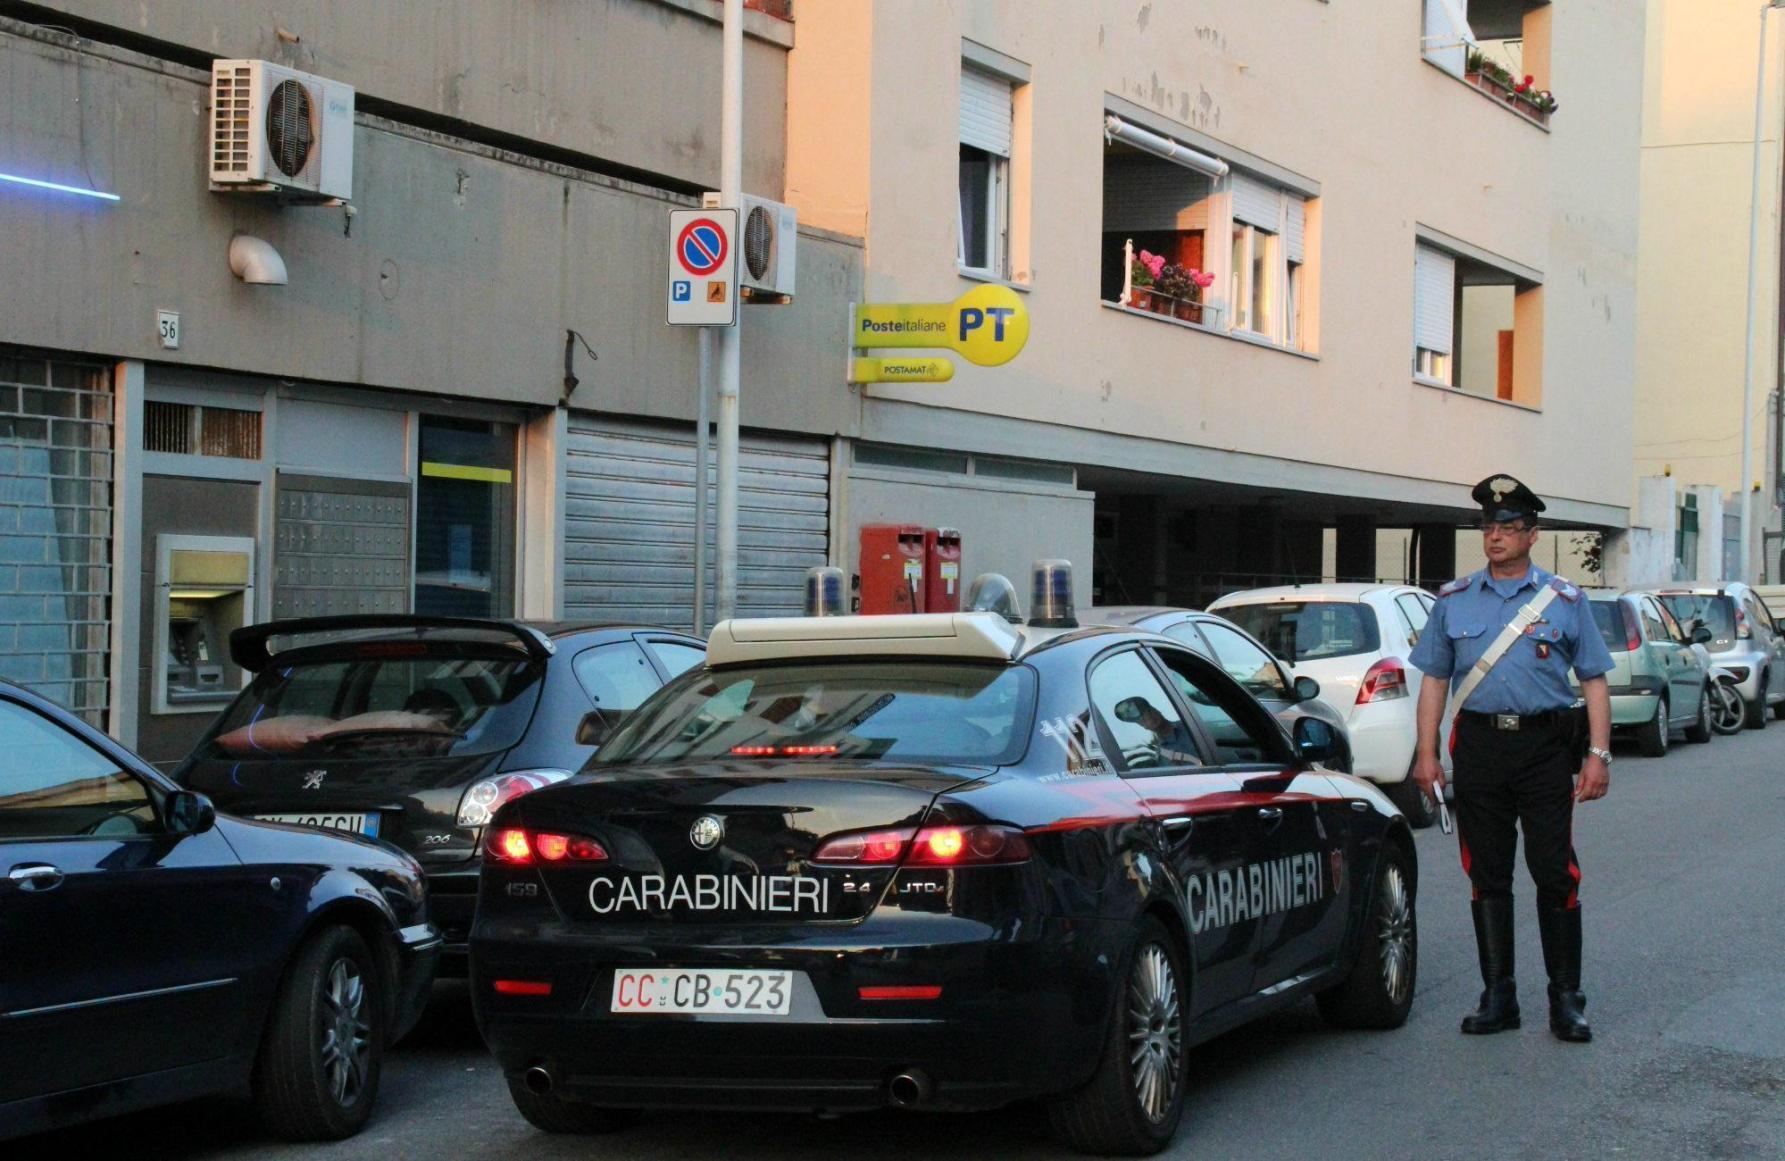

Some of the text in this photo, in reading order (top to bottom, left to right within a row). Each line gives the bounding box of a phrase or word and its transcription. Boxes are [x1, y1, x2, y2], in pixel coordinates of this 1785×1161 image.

[675, 282, 687, 299] P
[160, 320, 176, 339] 36
[960, 307, 1014, 342] PT
[884, 366, 926, 374] POSTAMAT
[1040, 714, 1106, 763] 112
[425, 835, 451, 844] 206
[506, 882, 538, 897] 159
[588, 873, 828, 915] CARABINIERI
[1187, 851, 1323, 934] CARABINIERI
[618, 974, 654, 1007] CC
[724, 974, 786, 1010] 523
